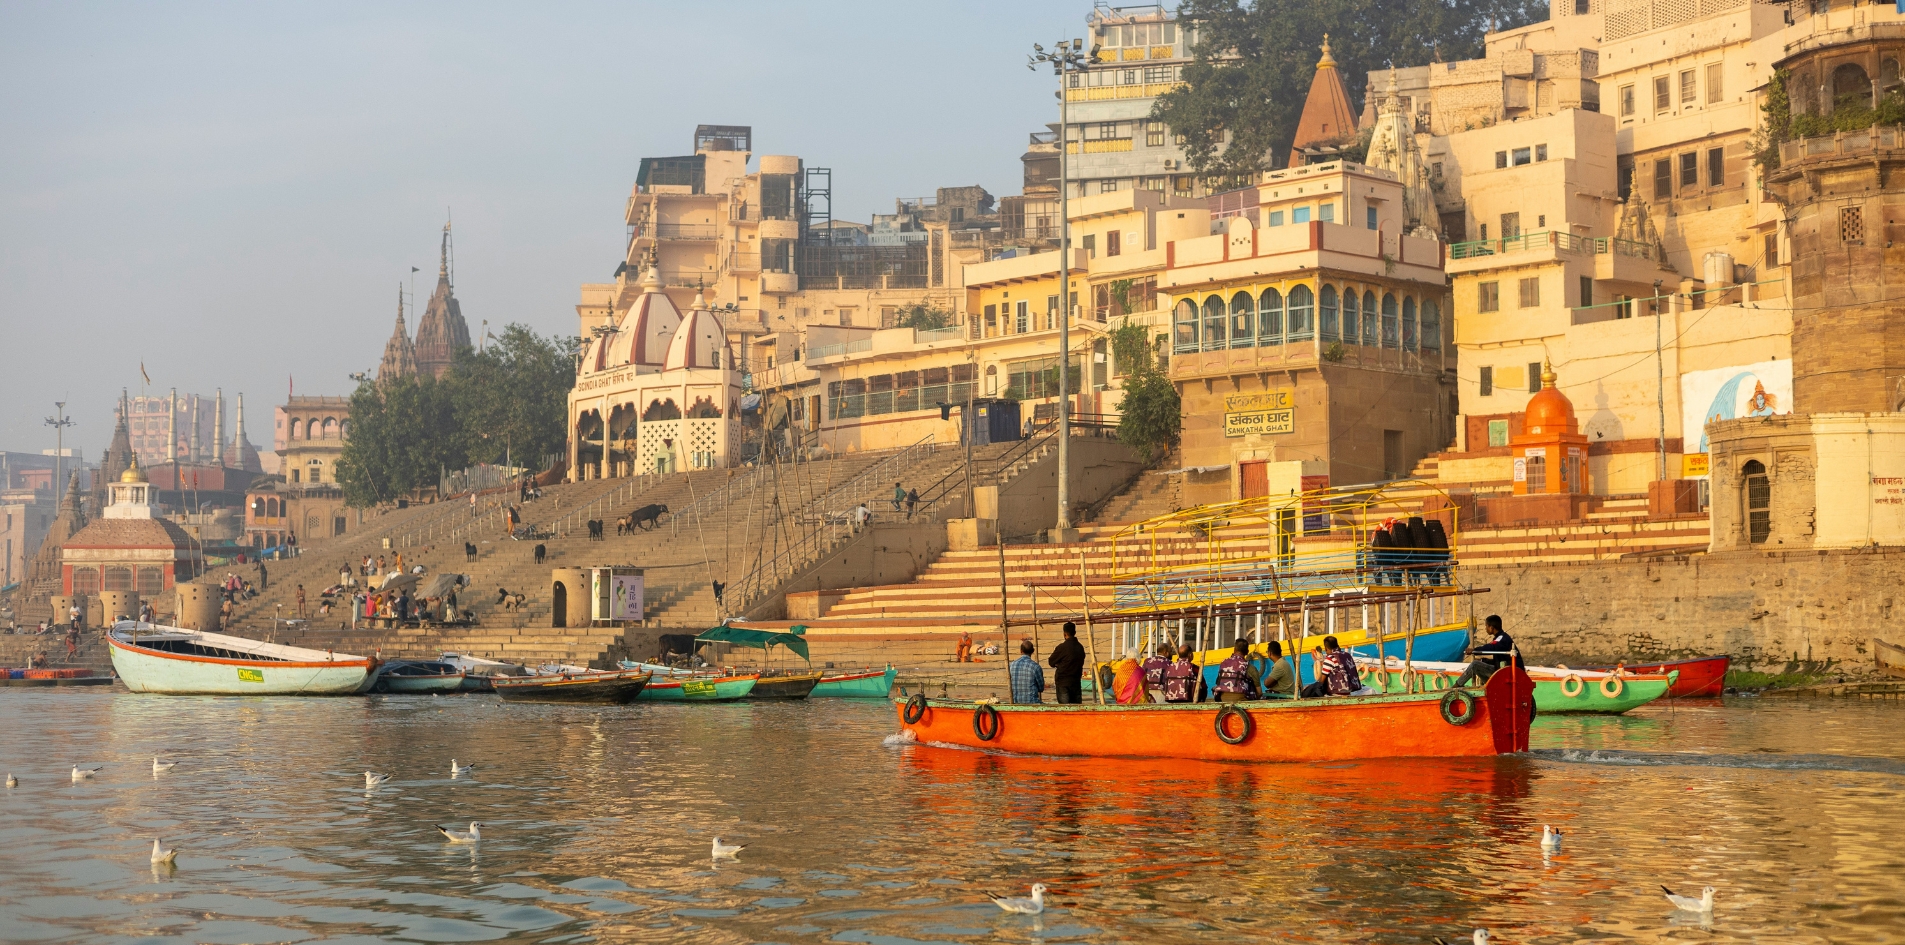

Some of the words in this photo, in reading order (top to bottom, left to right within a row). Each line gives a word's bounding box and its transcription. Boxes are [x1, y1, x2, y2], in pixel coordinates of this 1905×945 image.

[578, 380, 597, 392] SCINDIA
[599, 377, 611, 388] GHAT
[1229, 413, 1264, 425] संकठा
[1267, 412, 1290, 423] घाट
[1227, 426, 1264, 435] SANKATHA
[1266, 424, 1289, 432] GHAT
[239, 670, 253, 679] CNG
